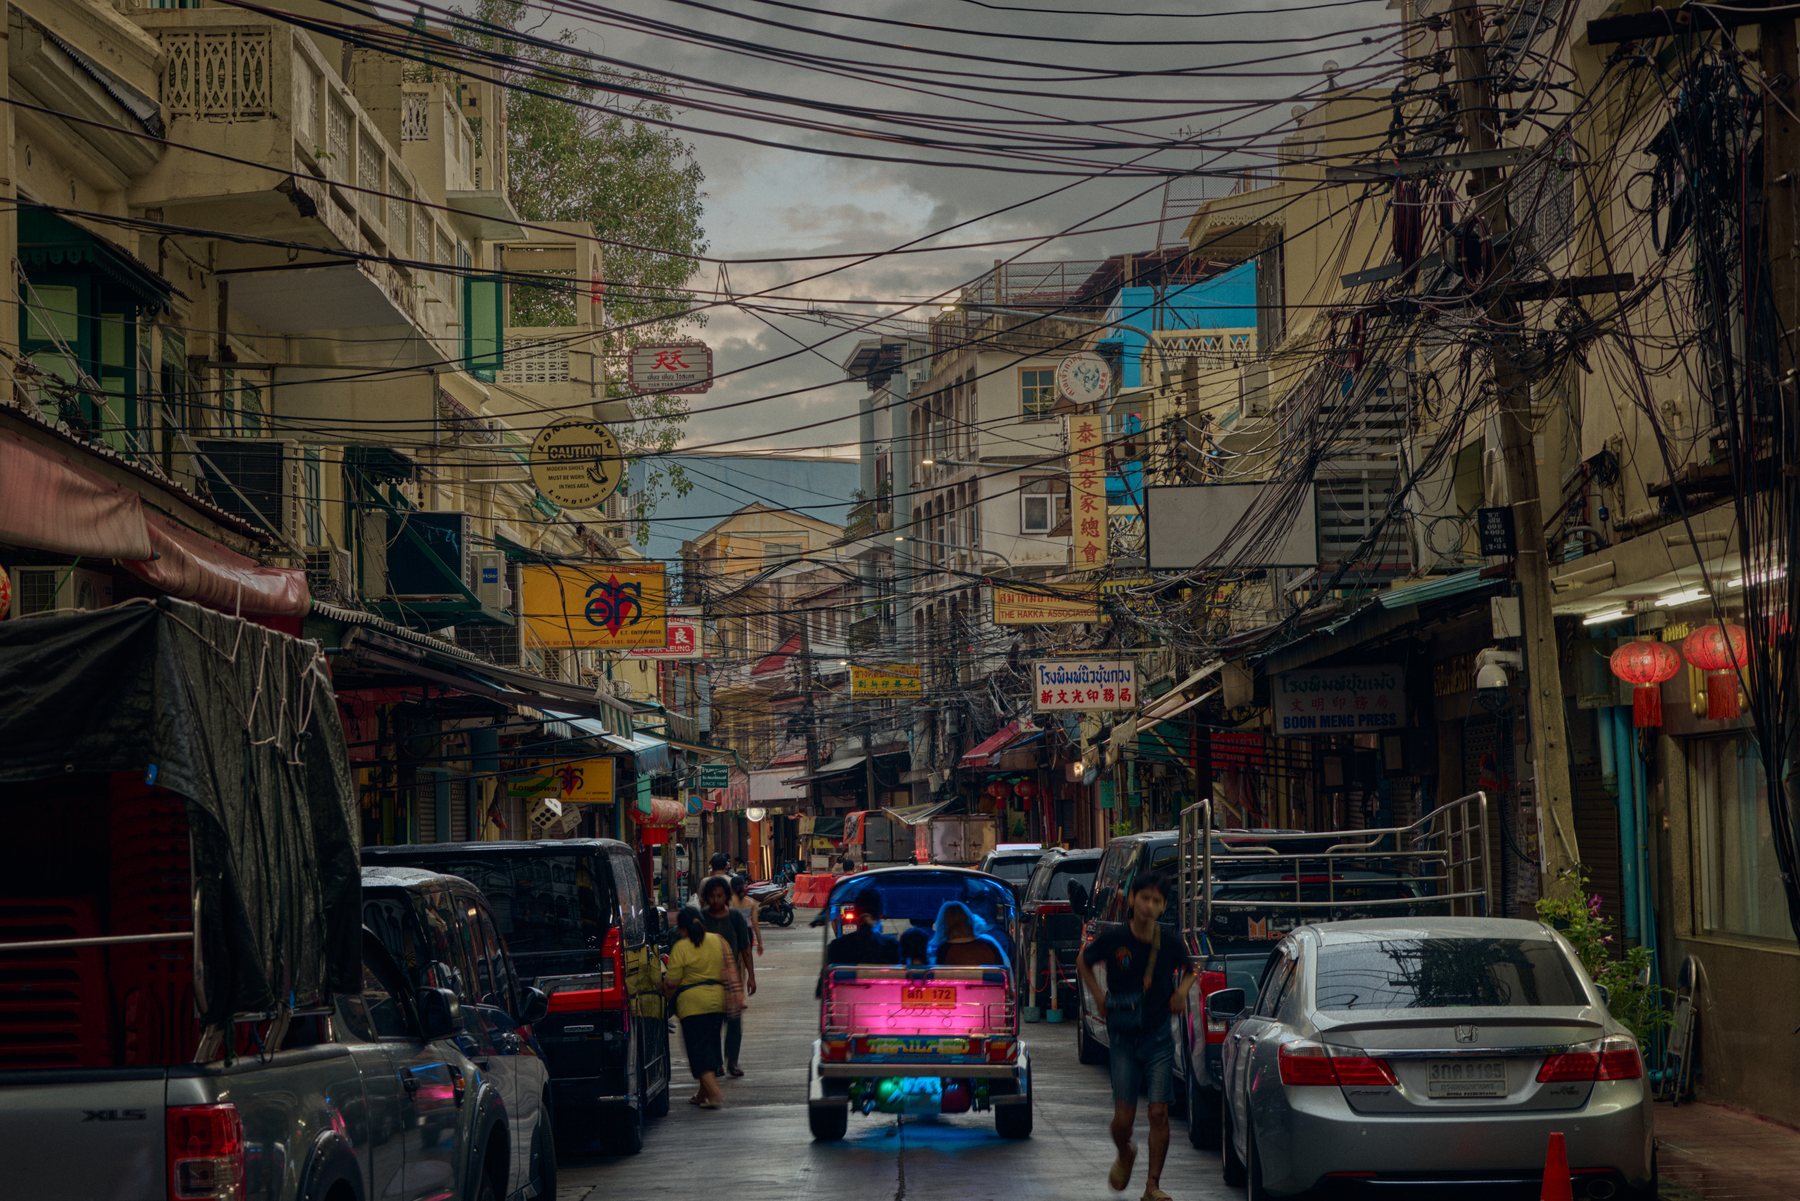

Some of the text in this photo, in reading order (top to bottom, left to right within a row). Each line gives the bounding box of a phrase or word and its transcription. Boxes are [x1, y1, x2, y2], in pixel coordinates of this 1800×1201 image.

[549, 446, 601, 459] CAUTION
[1076, 422, 1102, 563] 泰國客家總會
[1000, 608, 1098, 619] THE HAKKA ASSOCIATION
[1041, 688, 1132, 705] 新文光印務局
[1283, 712, 1397, 729] BOON MENG PRESS
[932, 989, 952, 1000] 172
[81, 1107, 147, 1123] XLS
